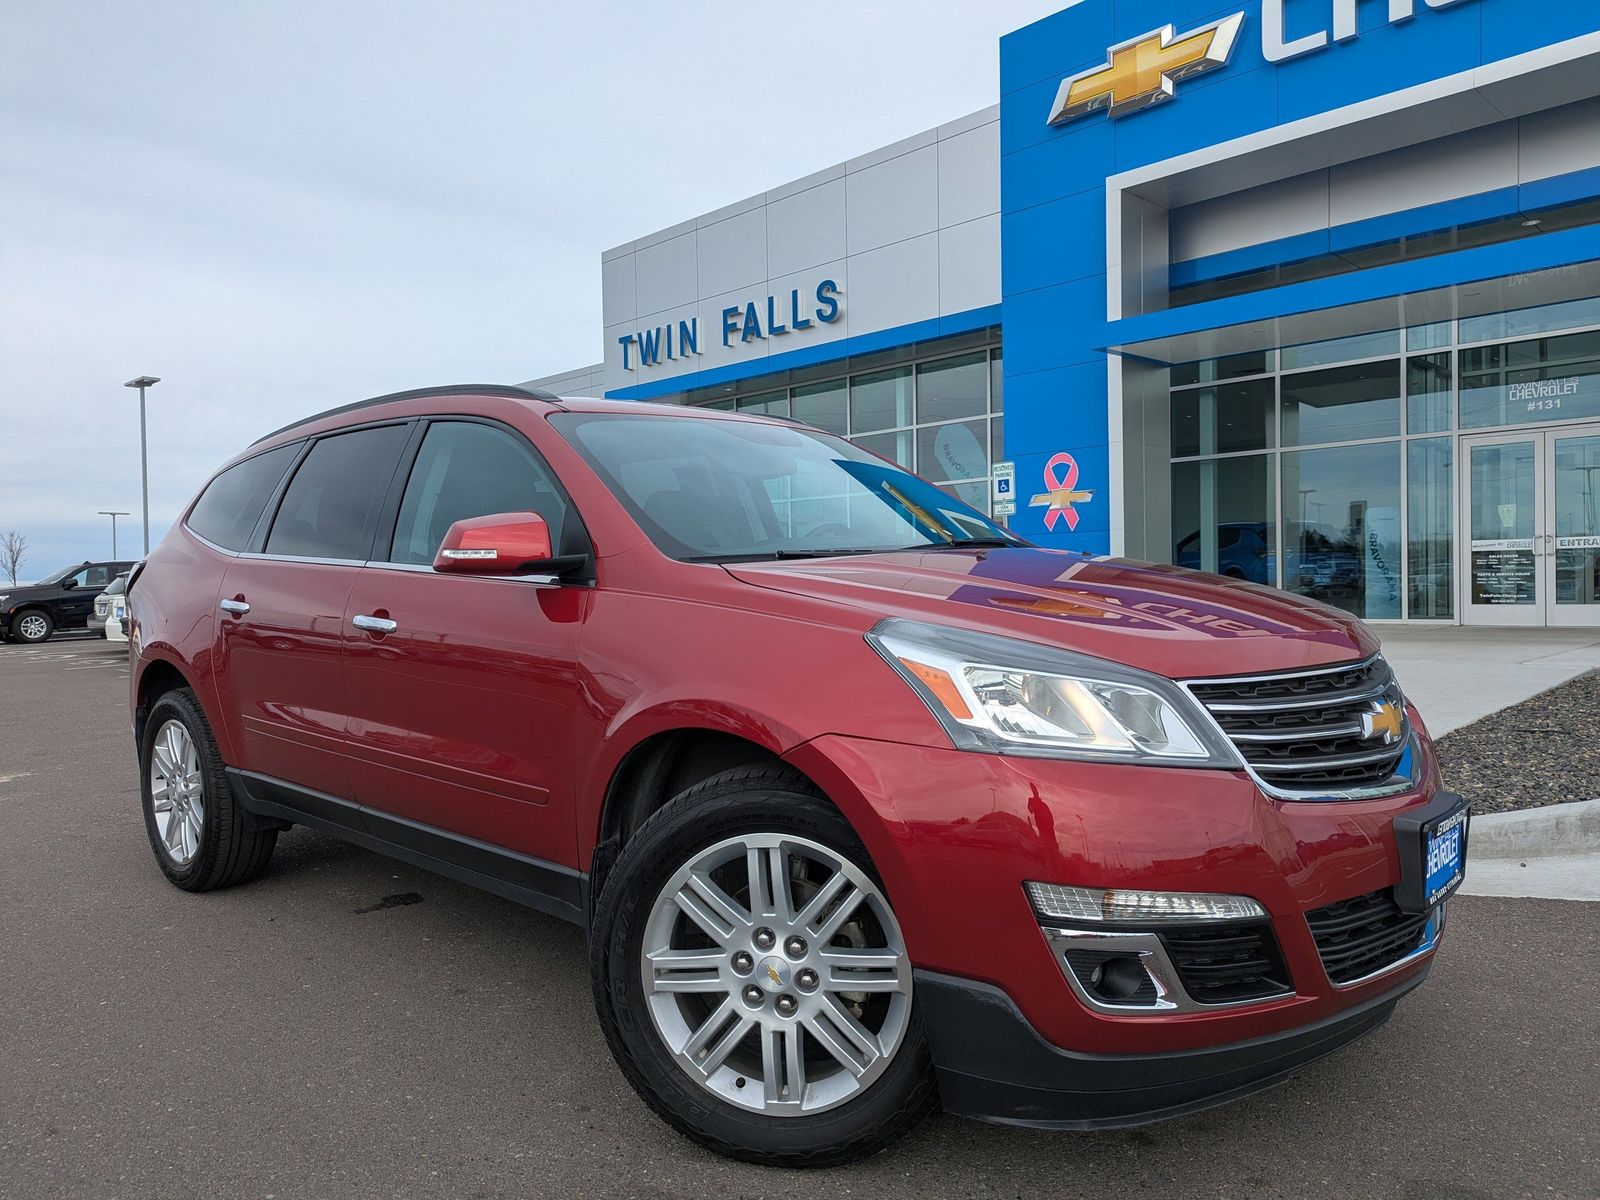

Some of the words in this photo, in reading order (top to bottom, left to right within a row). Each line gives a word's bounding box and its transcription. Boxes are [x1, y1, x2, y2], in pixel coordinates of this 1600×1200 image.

[618, 317, 701, 370] TWIN
[723, 279, 841, 347] FALLS
[1509, 383, 1579, 401] CHEVROLET
[1527, 398, 1561, 411] #131
